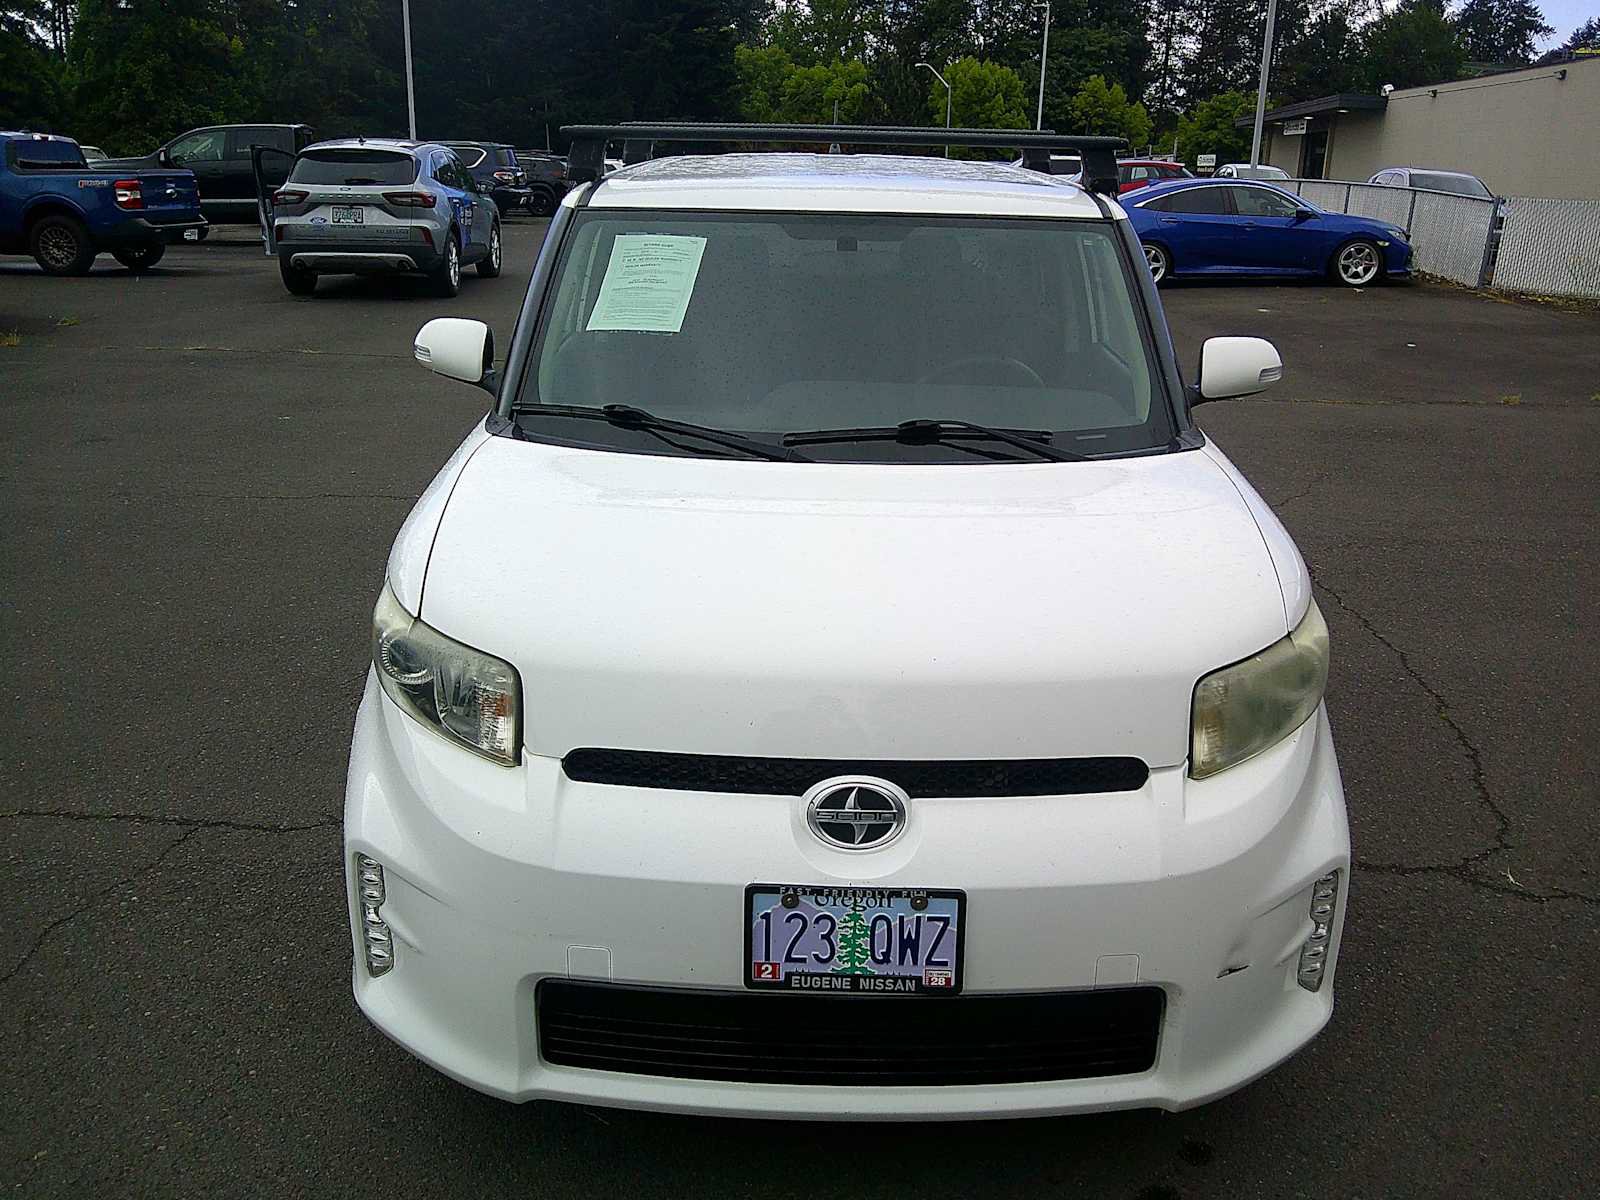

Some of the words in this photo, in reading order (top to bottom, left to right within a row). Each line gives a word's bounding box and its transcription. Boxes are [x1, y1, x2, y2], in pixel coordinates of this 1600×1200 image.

[760, 911, 837, 964] 123
[869, 914, 951, 966] QWZ
[760, 964, 773, 979] 2
[791, 975, 851, 989] EUGENE
[859, 978, 916, 992] NISSAN
[930, 976, 946, 986] 28
